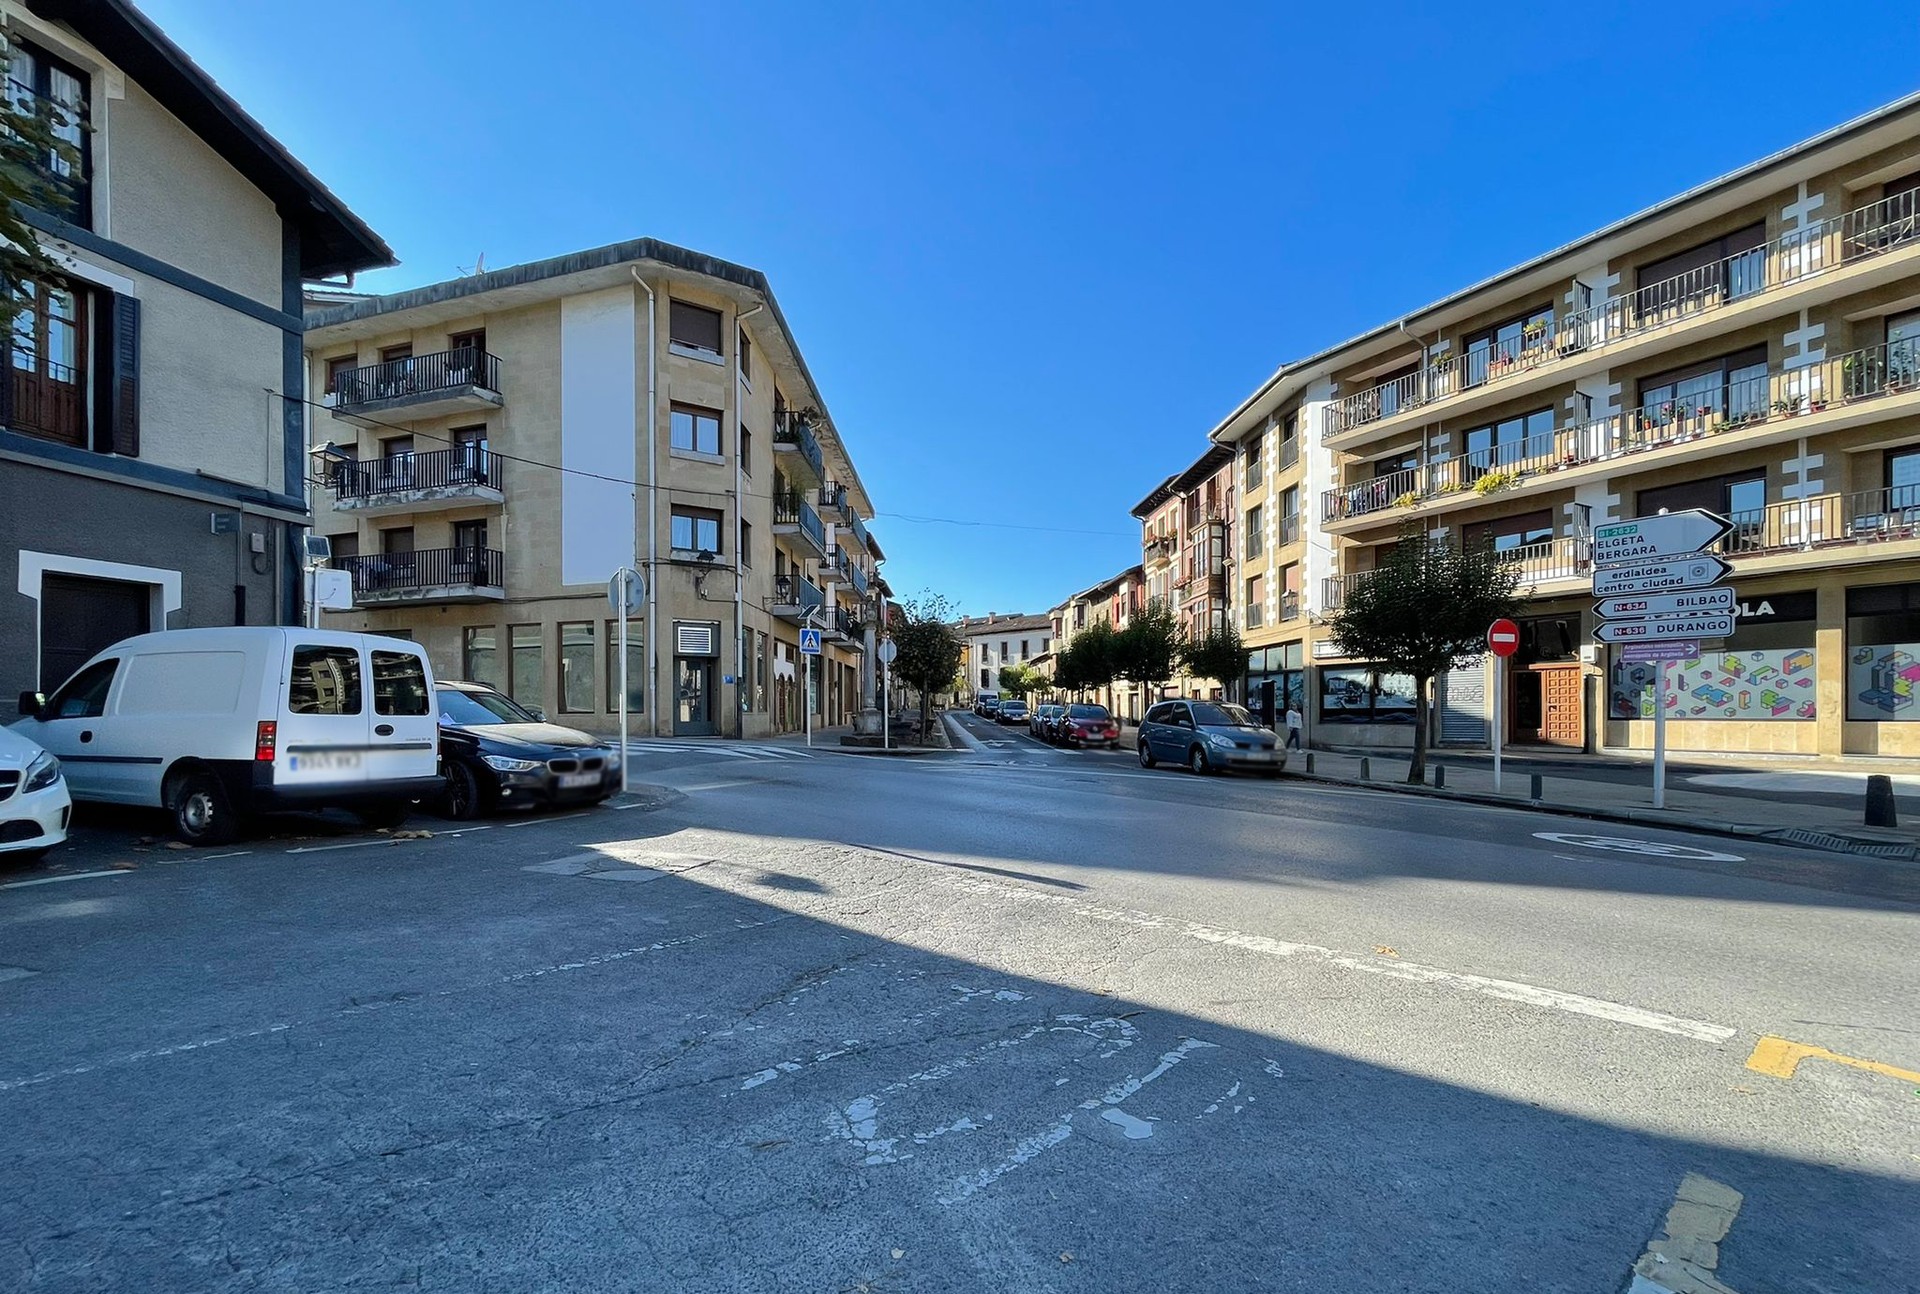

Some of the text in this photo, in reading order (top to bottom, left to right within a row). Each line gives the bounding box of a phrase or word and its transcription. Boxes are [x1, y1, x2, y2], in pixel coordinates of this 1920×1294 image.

[1597, 535, 1645, 549] ELGETA
[1597, 545, 1657, 560] BERGARA
[1611, 566, 1667, 580] erdialdea
[1597, 576, 1684, 594] centro ciudad
[1677, 594, 1728, 607] BILBAO
[1657, 620, 1728, 634] DURANGO
